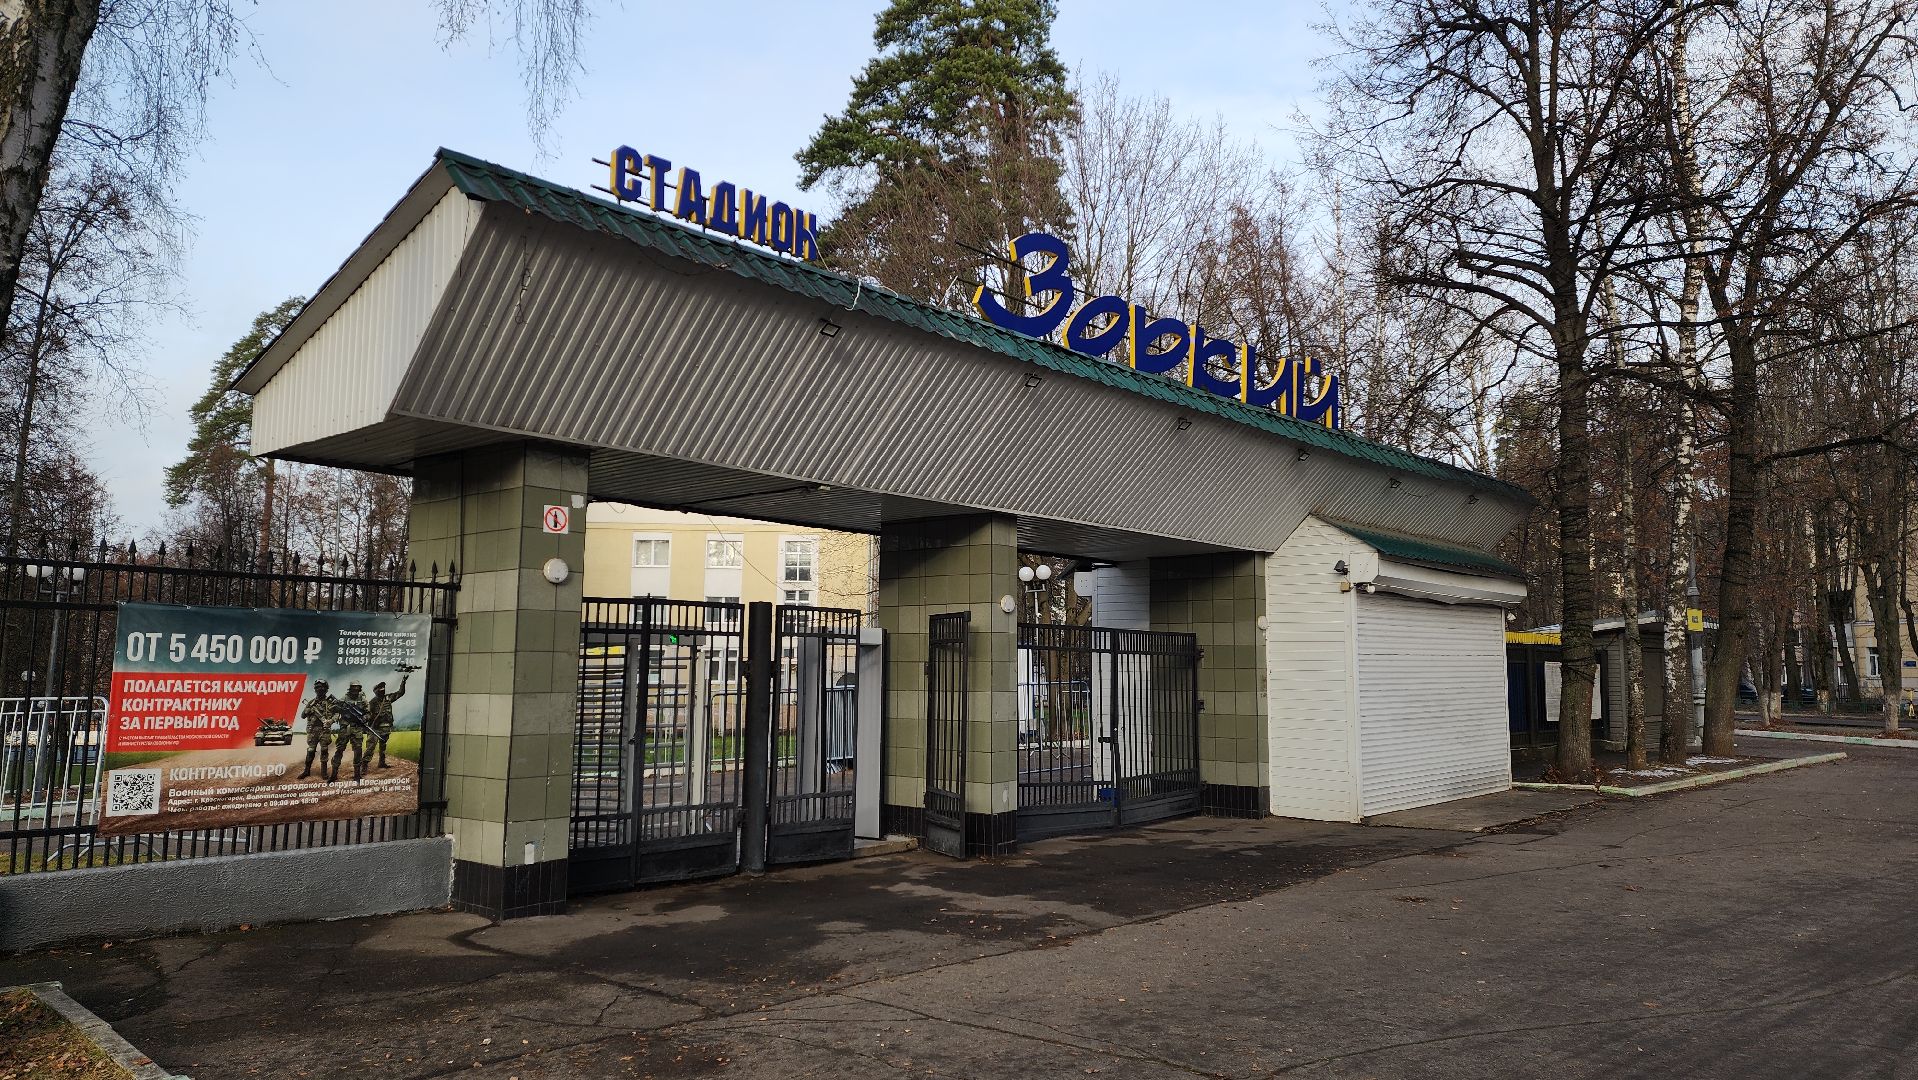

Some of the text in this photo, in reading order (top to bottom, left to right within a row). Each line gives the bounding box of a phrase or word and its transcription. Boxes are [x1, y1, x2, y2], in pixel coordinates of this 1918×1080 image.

[610, 144, 818, 261] СТАДИОН
[972, 232, 1338, 430] Зоркий
[126, 631, 163, 662] ОТ
[169, 633, 186, 663] 5
[190, 633, 244, 664] 450
[250, 635, 298, 664] 000
[346, 638, 370, 646] (495)
[338, 647, 416, 656] 8 (495) 562-53-12
[345, 657, 368, 665] (985)
[123, 679, 299, 695] ПОЛАГАЕТСЯ КАЖДОМУ
[121, 698, 242, 712] КОНТРАКТНИКУ
[120, 713, 240, 731] ЗА ПЕРВЫЙ ГОД
[170, 763, 286, 780] КОНТРАКТМО.РФ
[169, 778, 410, 797] Военный комиссариат городского округа Красногорск
